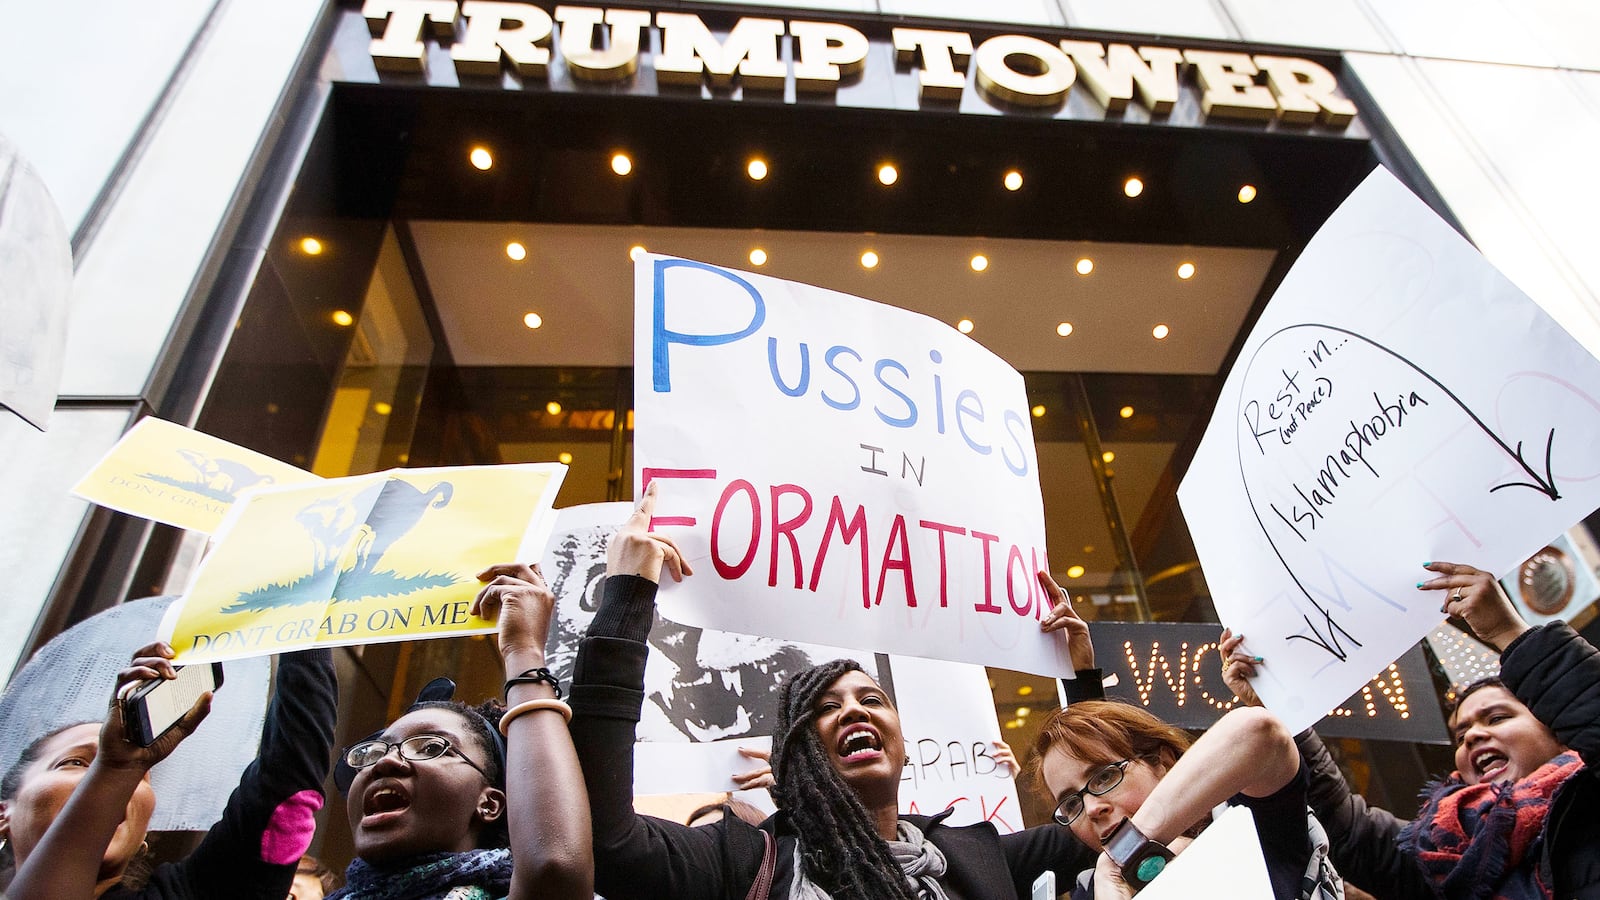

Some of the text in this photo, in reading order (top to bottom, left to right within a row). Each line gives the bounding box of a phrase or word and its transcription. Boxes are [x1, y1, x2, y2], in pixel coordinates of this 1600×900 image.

[363, 0, 1357, 129] TRUMP TOWER
[652, 259, 1030, 477] Pussies
[1243, 369, 1300, 456] Rest
[859, 443, 926, 487] IN
[1270, 391, 1429, 542] Islamaphobia
[641, 467, 1054, 621] FORMATION
[189, 600, 471, 657] DONT GRAB ON ME
[1123, 639, 1410, 720] WON
